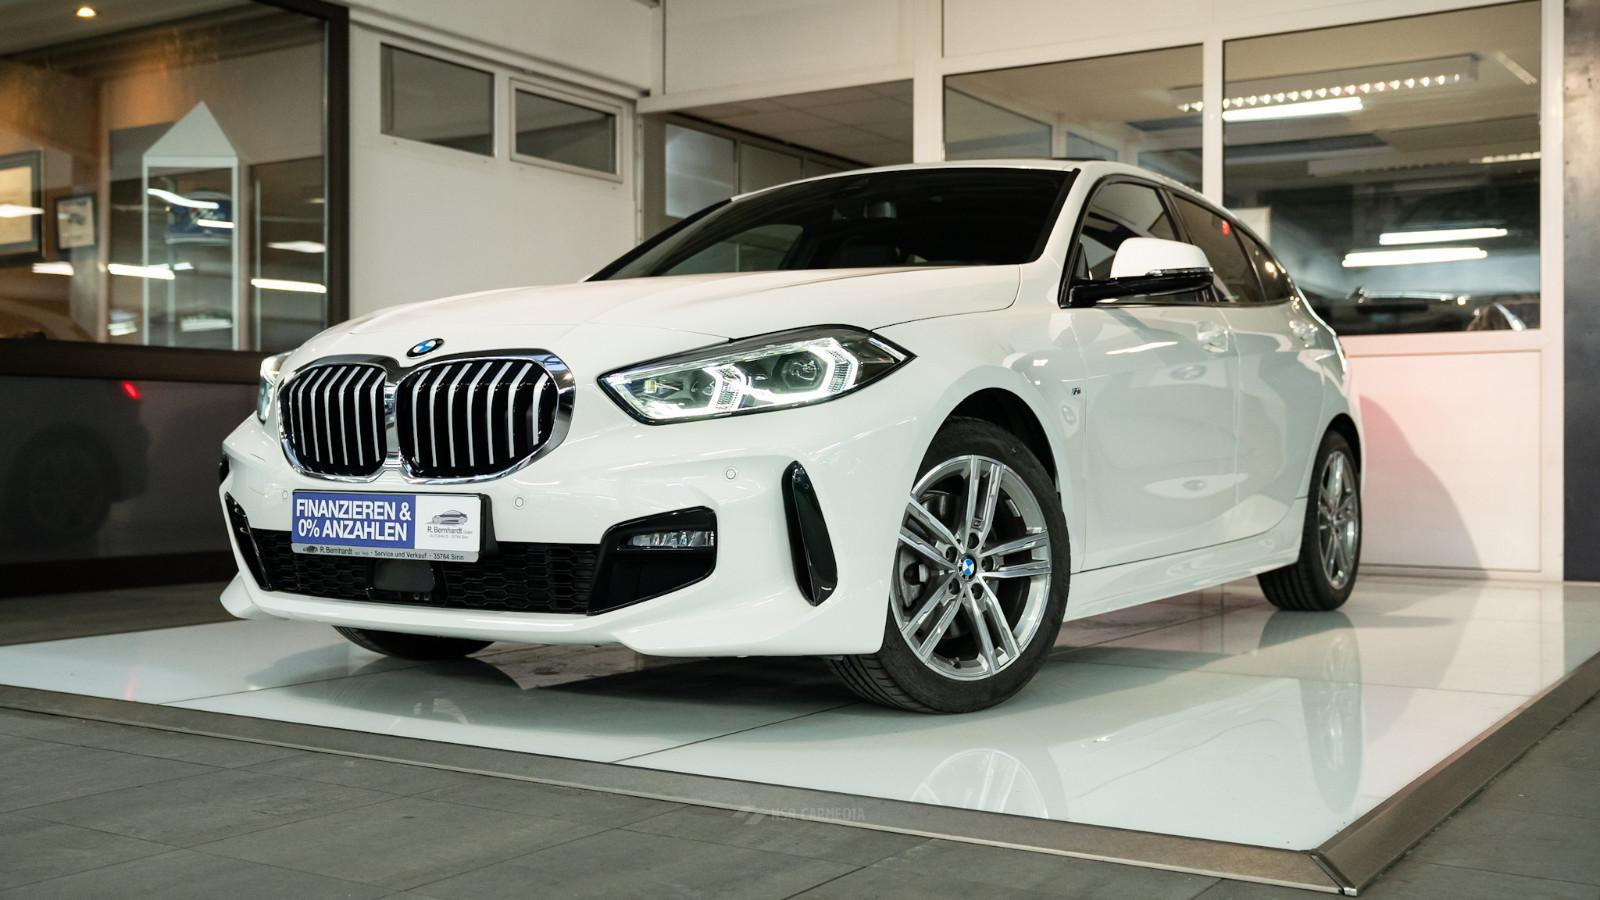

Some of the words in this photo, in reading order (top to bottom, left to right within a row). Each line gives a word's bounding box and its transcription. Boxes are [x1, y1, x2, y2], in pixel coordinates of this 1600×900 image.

[296, 499, 396, 520] FINANZIEREN
[399, 502, 411, 521] &
[298, 519, 320, 537] 0%
[322, 520, 407, 541] ANZAHLEN
